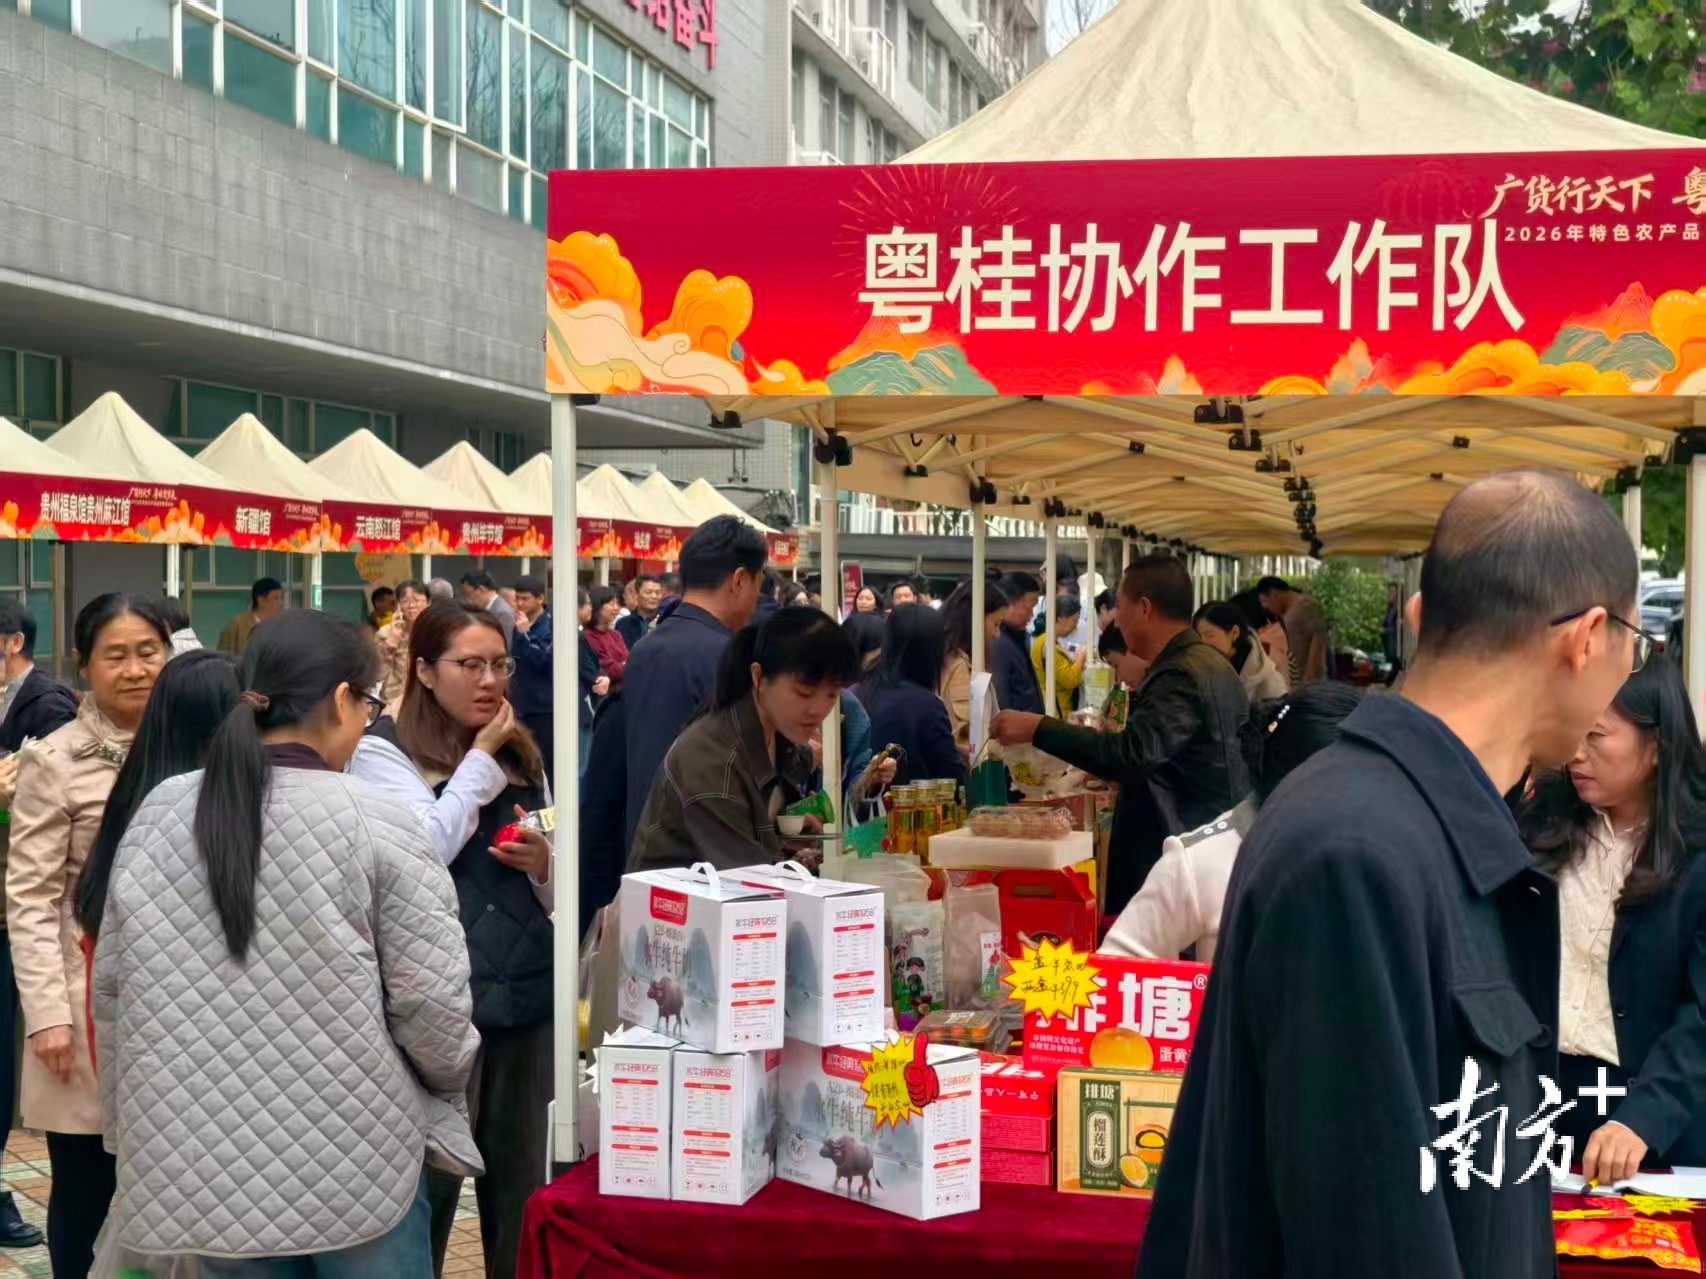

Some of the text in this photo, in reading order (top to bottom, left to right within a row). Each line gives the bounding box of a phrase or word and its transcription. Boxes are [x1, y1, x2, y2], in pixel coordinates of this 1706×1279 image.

[1479, 173, 1654, 219] 广货行天下
[1505, 223, 1700, 242] 2026年特色农产品
[858, 219, 1525, 336] 粤桂协作工作队
[40, 491, 131, 526] 贵州福泉馆贵州麻江馆
[235, 507, 271, 536] 新疆馆
[355, 515, 401, 541] 云南怒江馆
[462, 522, 504, 545] 贵州毕节馆
[1159, 1046, 1190, 1064] 蛋黄
[1085, 1083, 1115, 1100] 排塘
